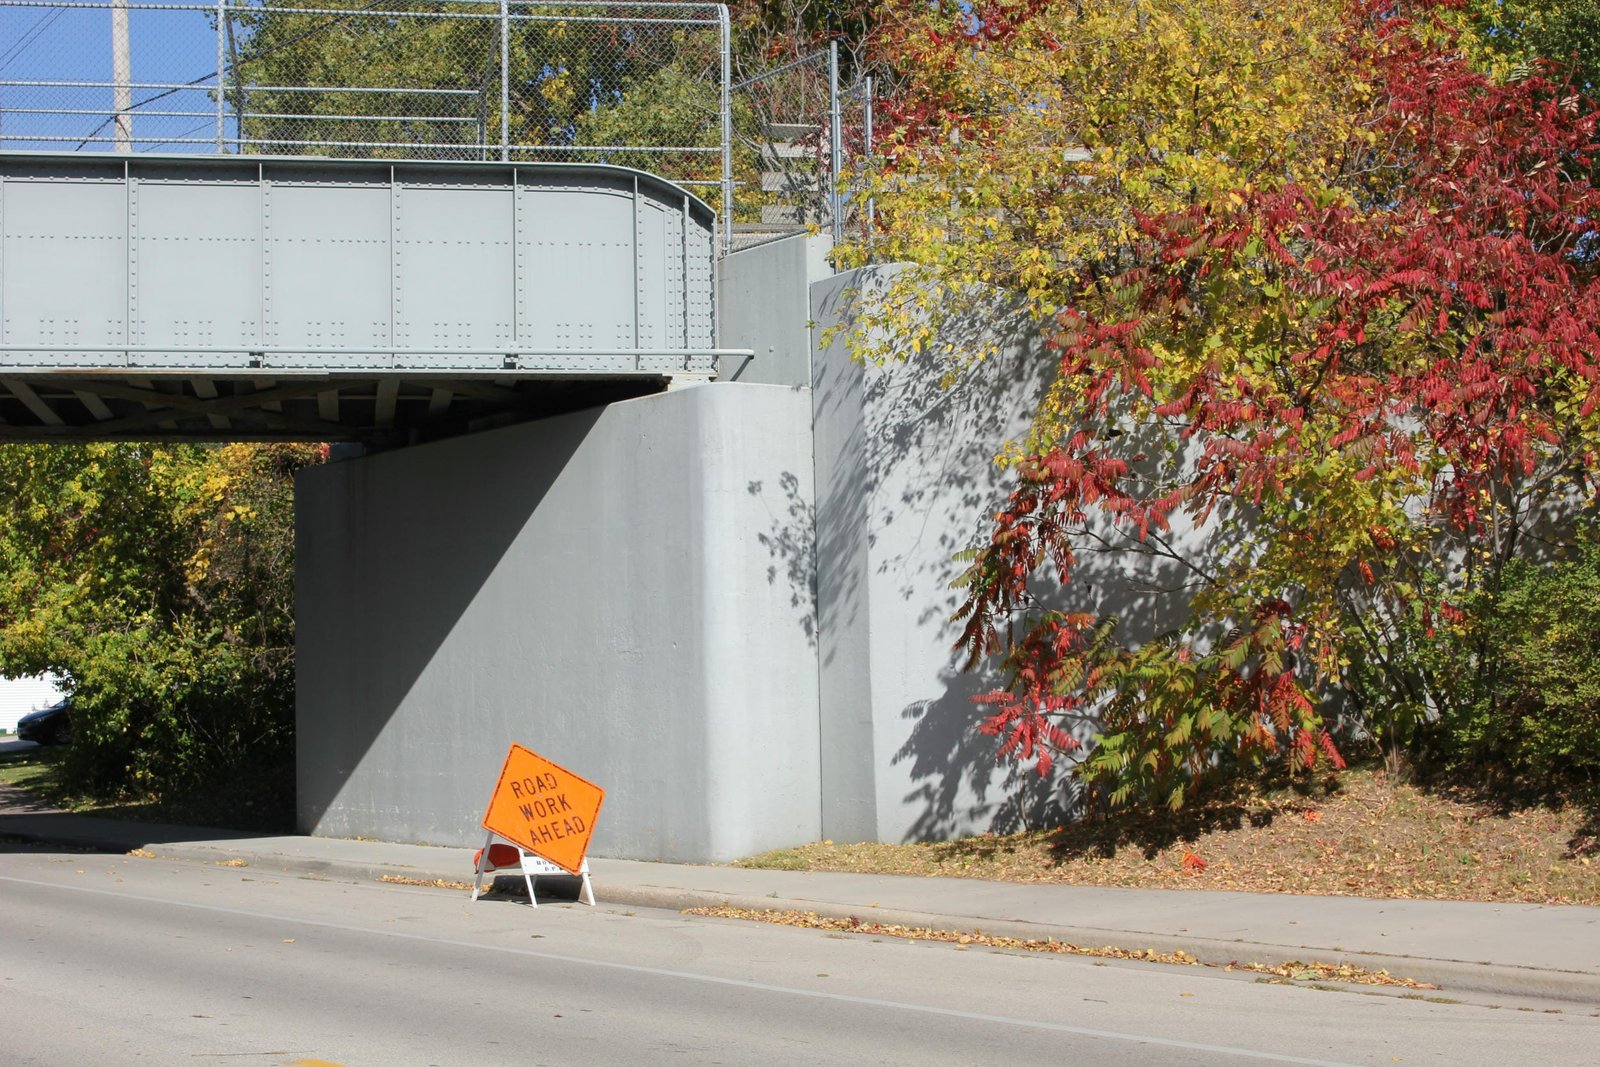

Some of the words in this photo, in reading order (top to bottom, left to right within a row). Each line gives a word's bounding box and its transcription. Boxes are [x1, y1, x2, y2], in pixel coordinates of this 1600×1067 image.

[510, 773, 558, 799] ROAD
[519, 794, 573, 822] WORK
[529, 815, 586, 845] AHEAD
